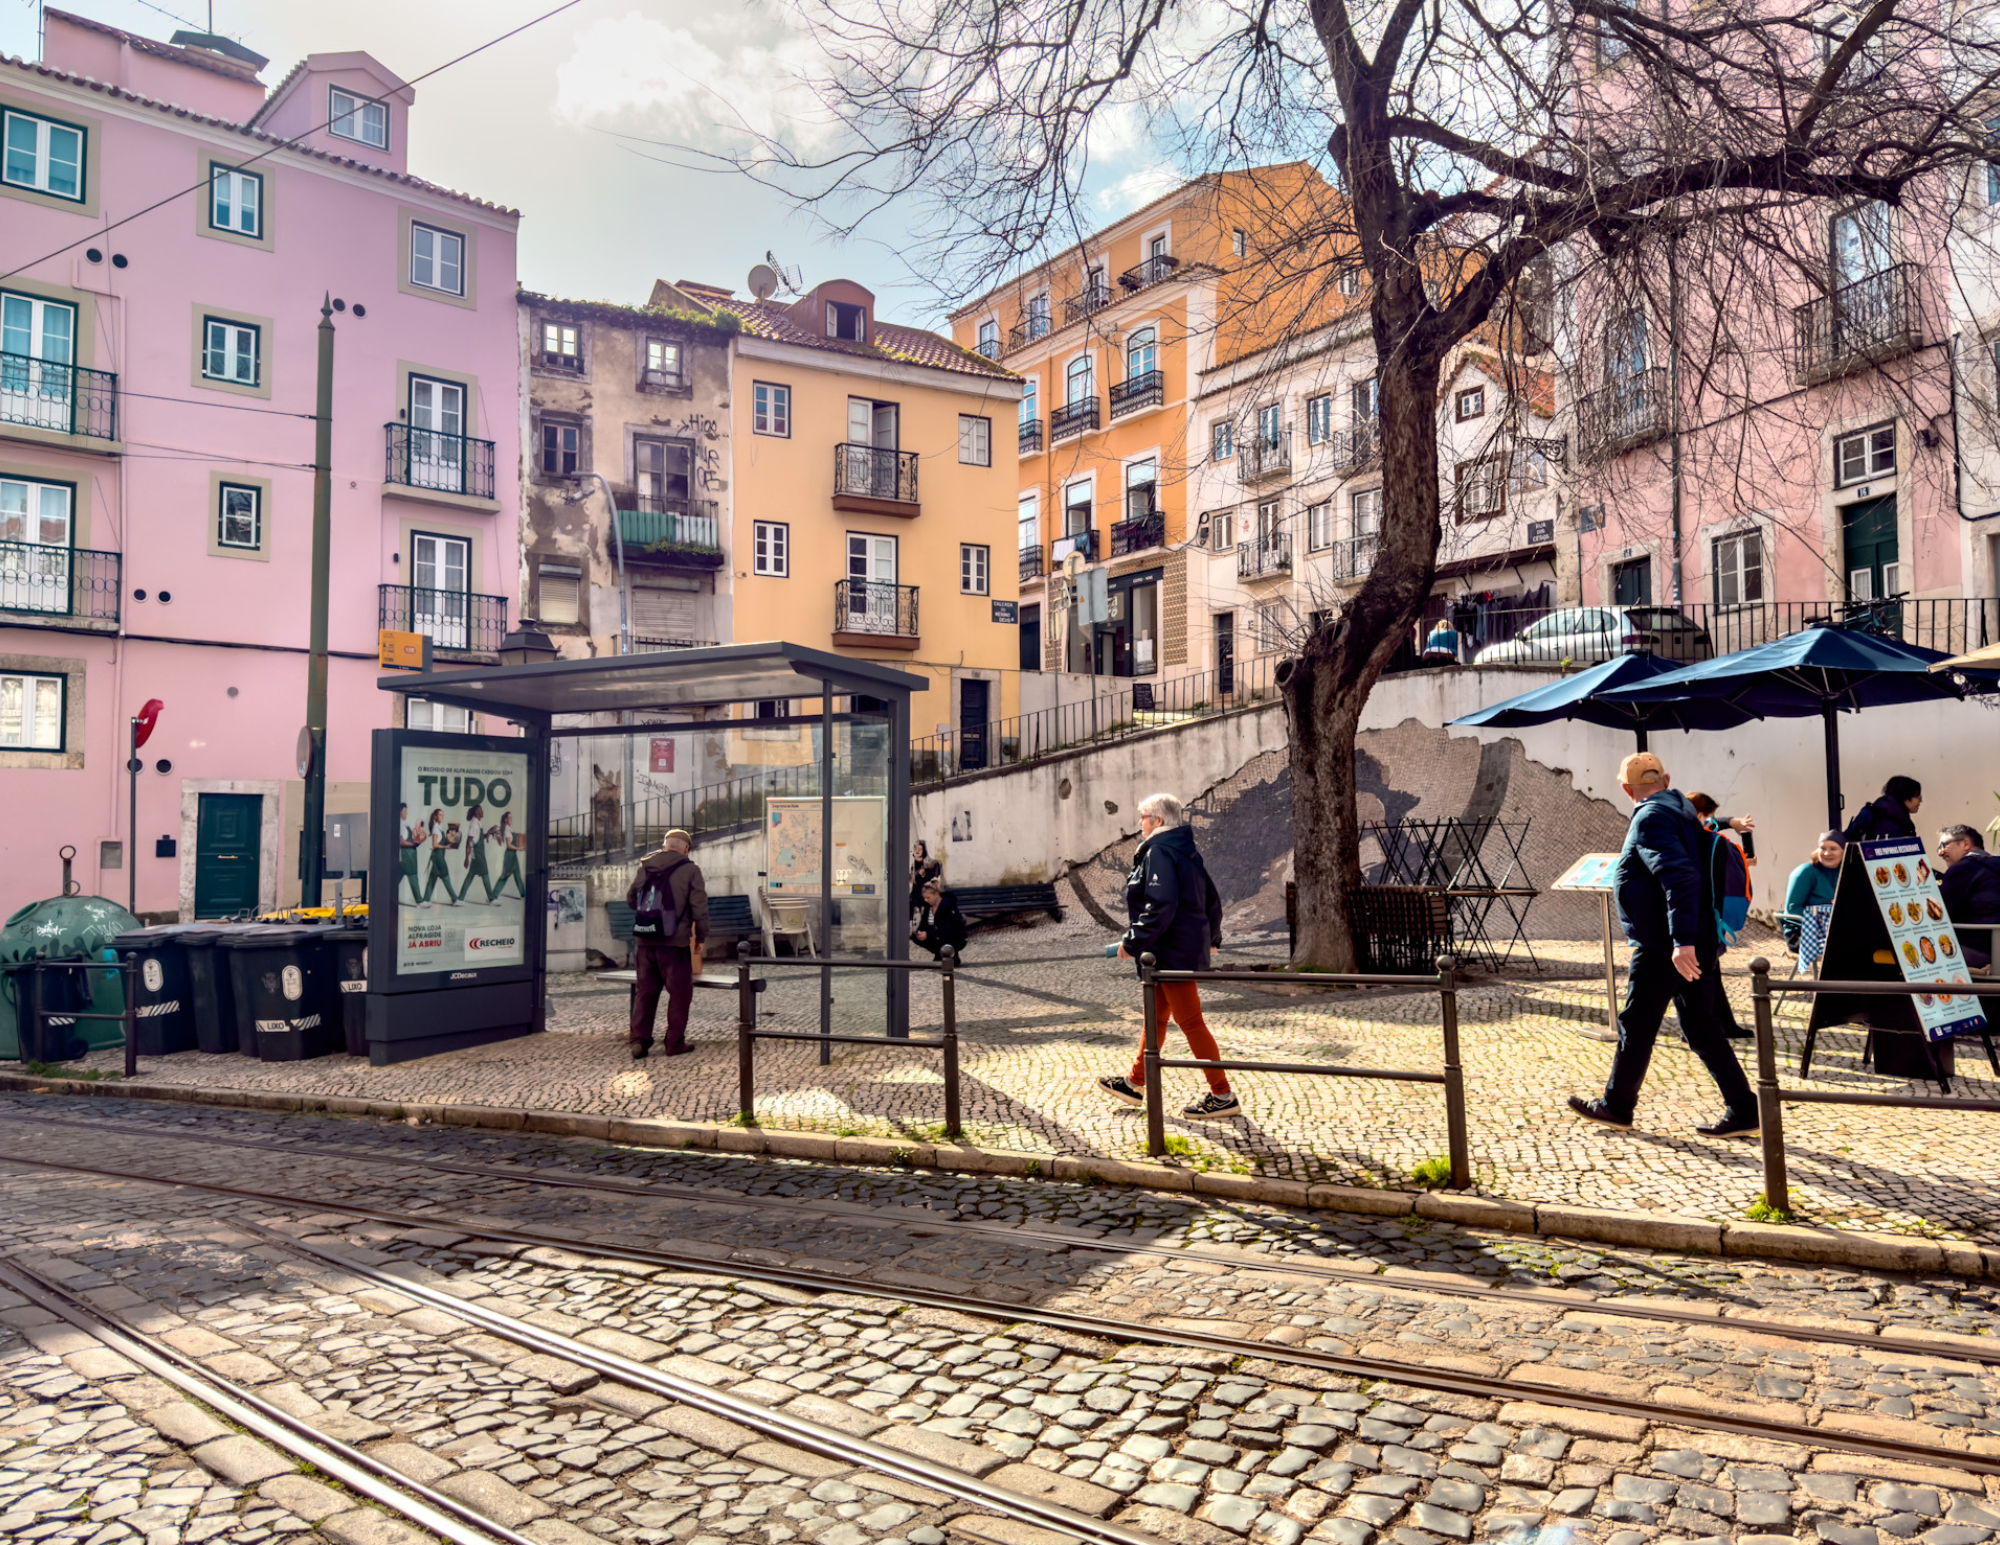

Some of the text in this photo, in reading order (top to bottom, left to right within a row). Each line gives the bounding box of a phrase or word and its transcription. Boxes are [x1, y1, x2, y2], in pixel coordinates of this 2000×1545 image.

[417, 775, 512, 808] TUDO
[408, 931, 442, 939] ALFRAGIDE
[407, 940, 442, 949] JÁ ABRIU
[479, 938, 515, 947] RECHEIO
[450, 972, 477, 980] JCDecaux
[348, 983, 362, 991] LIXO
[267, 1022, 284, 1030] LIXO
